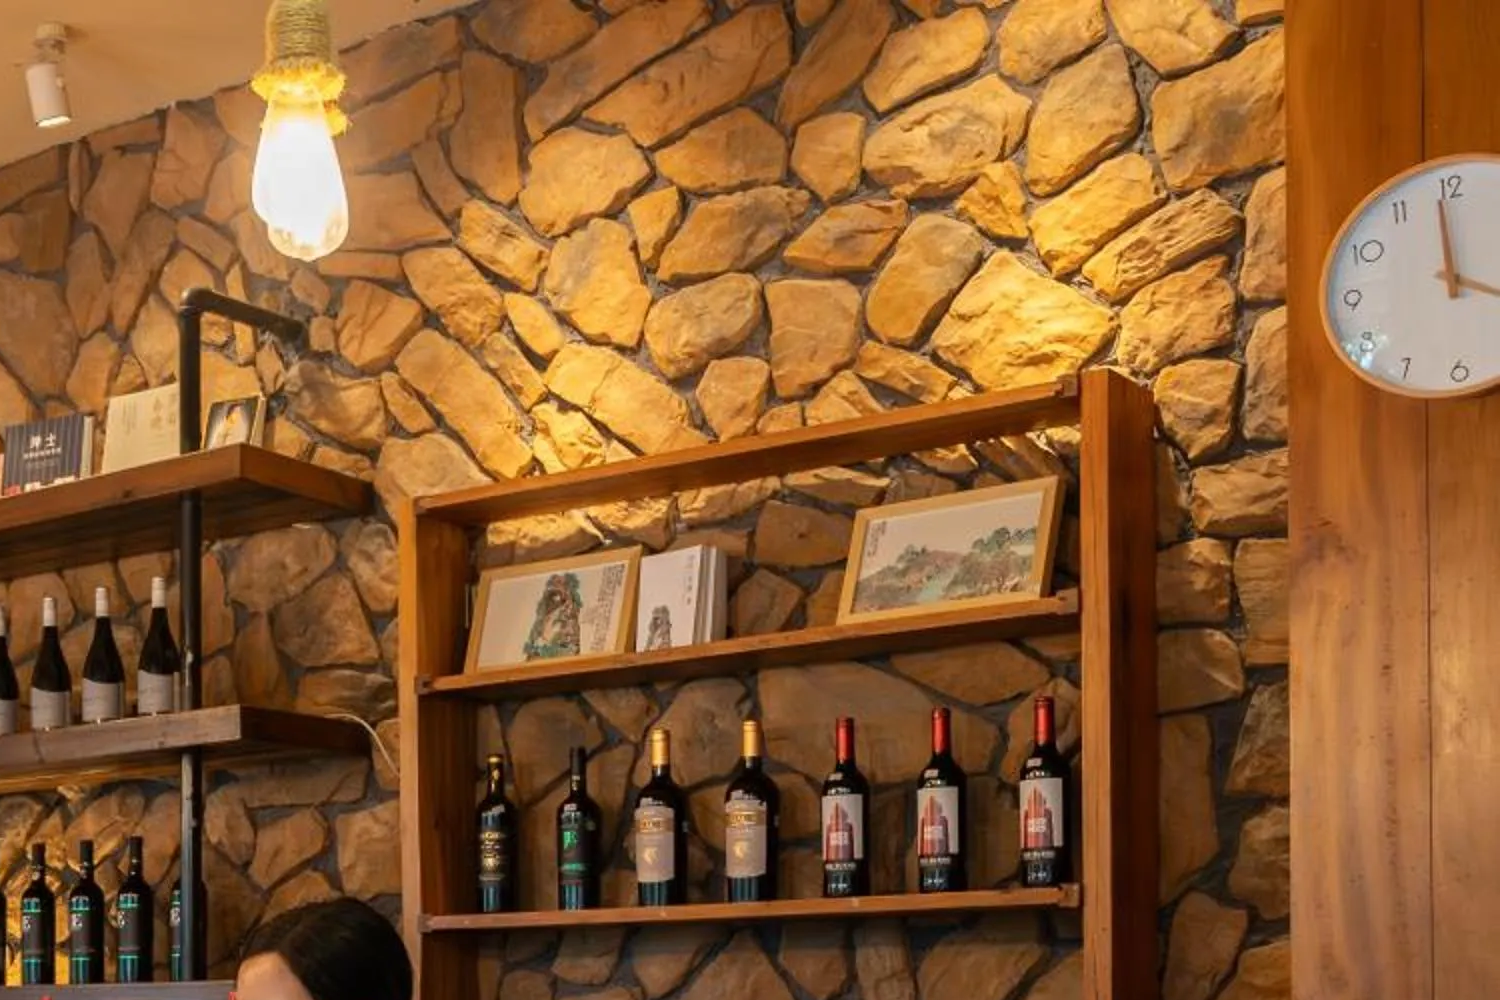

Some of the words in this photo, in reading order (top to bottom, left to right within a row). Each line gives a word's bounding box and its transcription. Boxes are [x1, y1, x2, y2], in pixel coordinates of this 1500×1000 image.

[1440, 174, 1464, 200] 12
[1392, 200, 1408, 224] 11
[1352, 239, 1385, 265] 10
[1343, 289, 1363, 310] 9
[1359, 331, 1376, 353] 8
[1401, 357, 1412, 380] 7
[1450, 359, 1470, 383] 6
